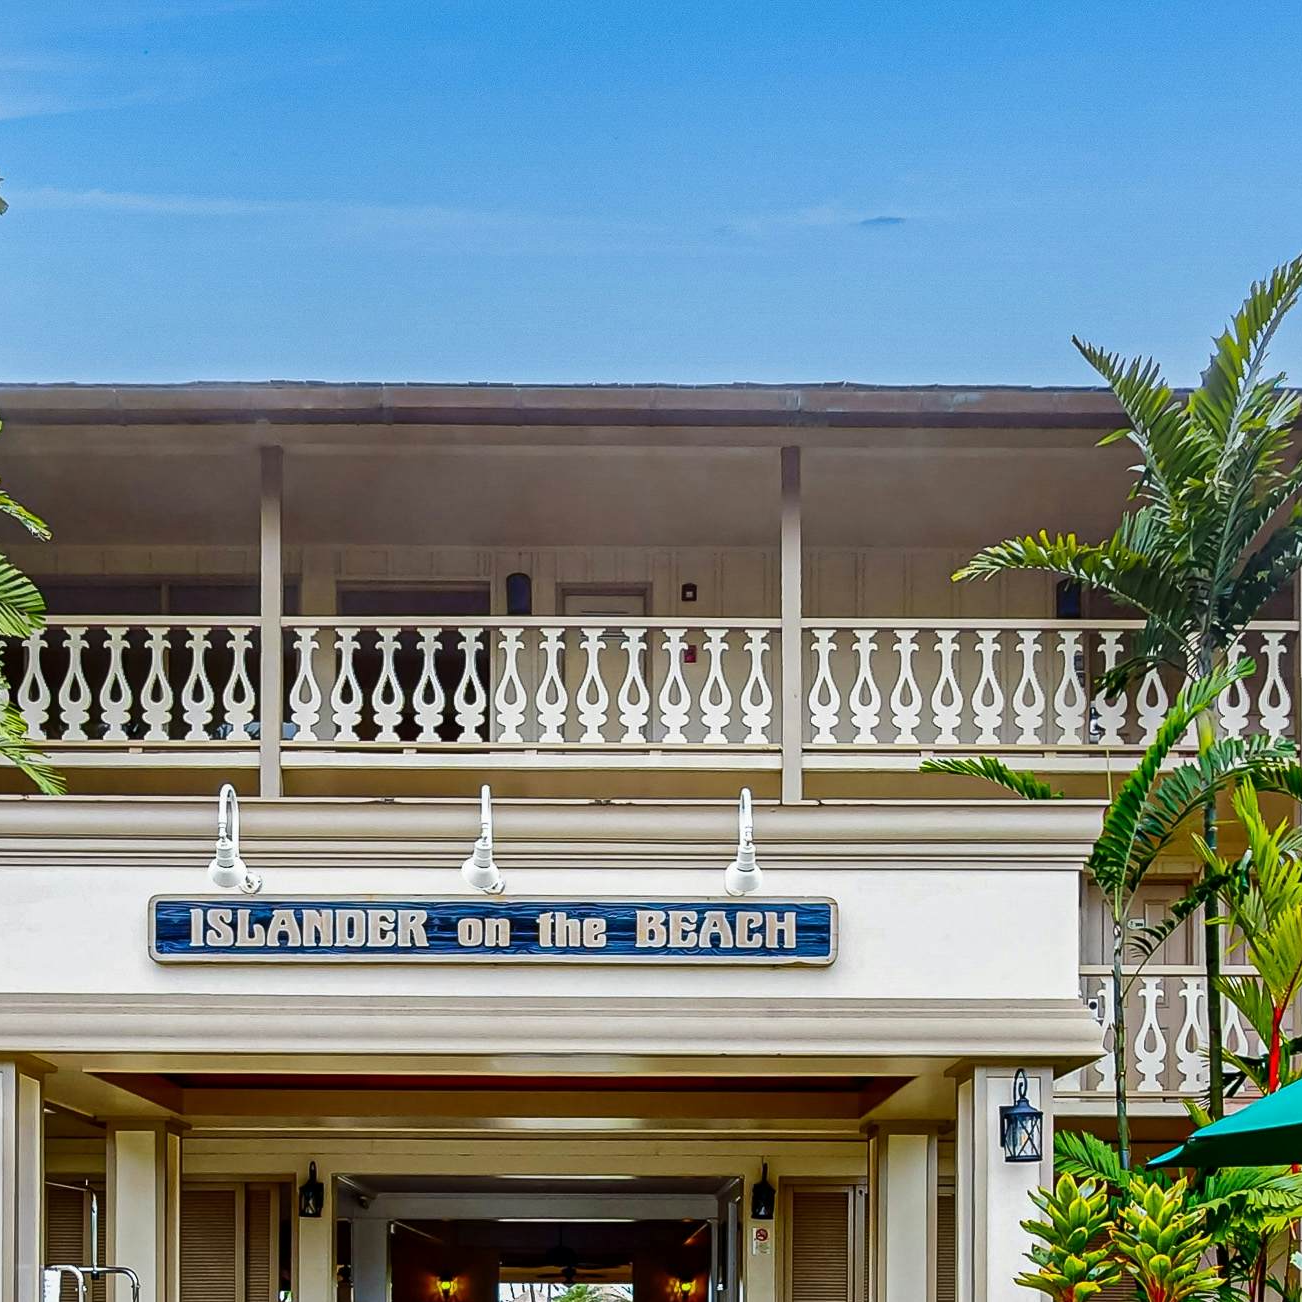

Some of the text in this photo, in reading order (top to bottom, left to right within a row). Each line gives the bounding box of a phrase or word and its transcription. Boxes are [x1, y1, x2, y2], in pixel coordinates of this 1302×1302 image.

[189, 908, 797, 949] ISLANDER on the BEACH
